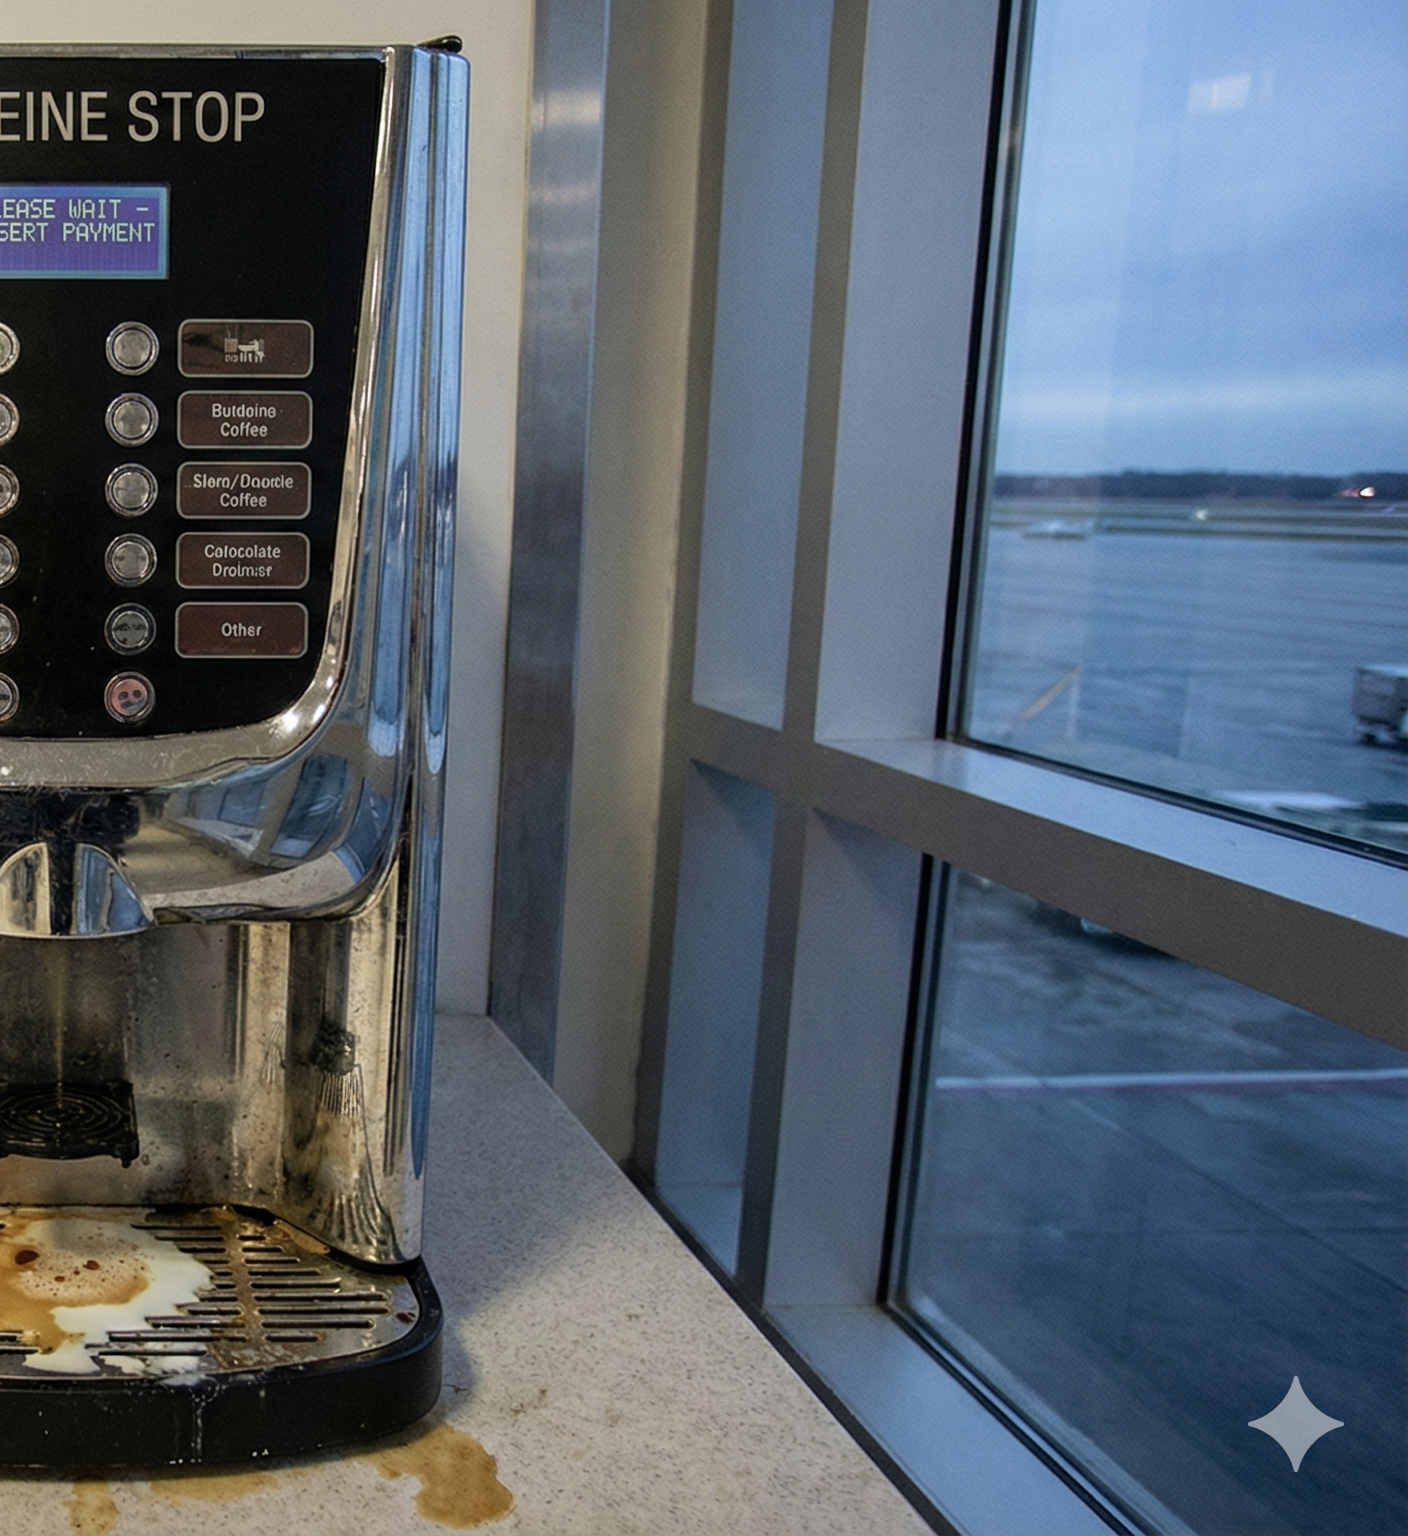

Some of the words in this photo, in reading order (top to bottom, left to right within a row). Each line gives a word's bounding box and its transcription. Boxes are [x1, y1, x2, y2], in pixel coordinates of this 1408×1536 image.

[128, 90, 266, 143] STOP
[68, 198, 122, 219] WAIT
[63, 222, 155, 242] PAYMENT
[220, 421, 269, 437] Coffee
[219, 491, 268, 508] Coffee
